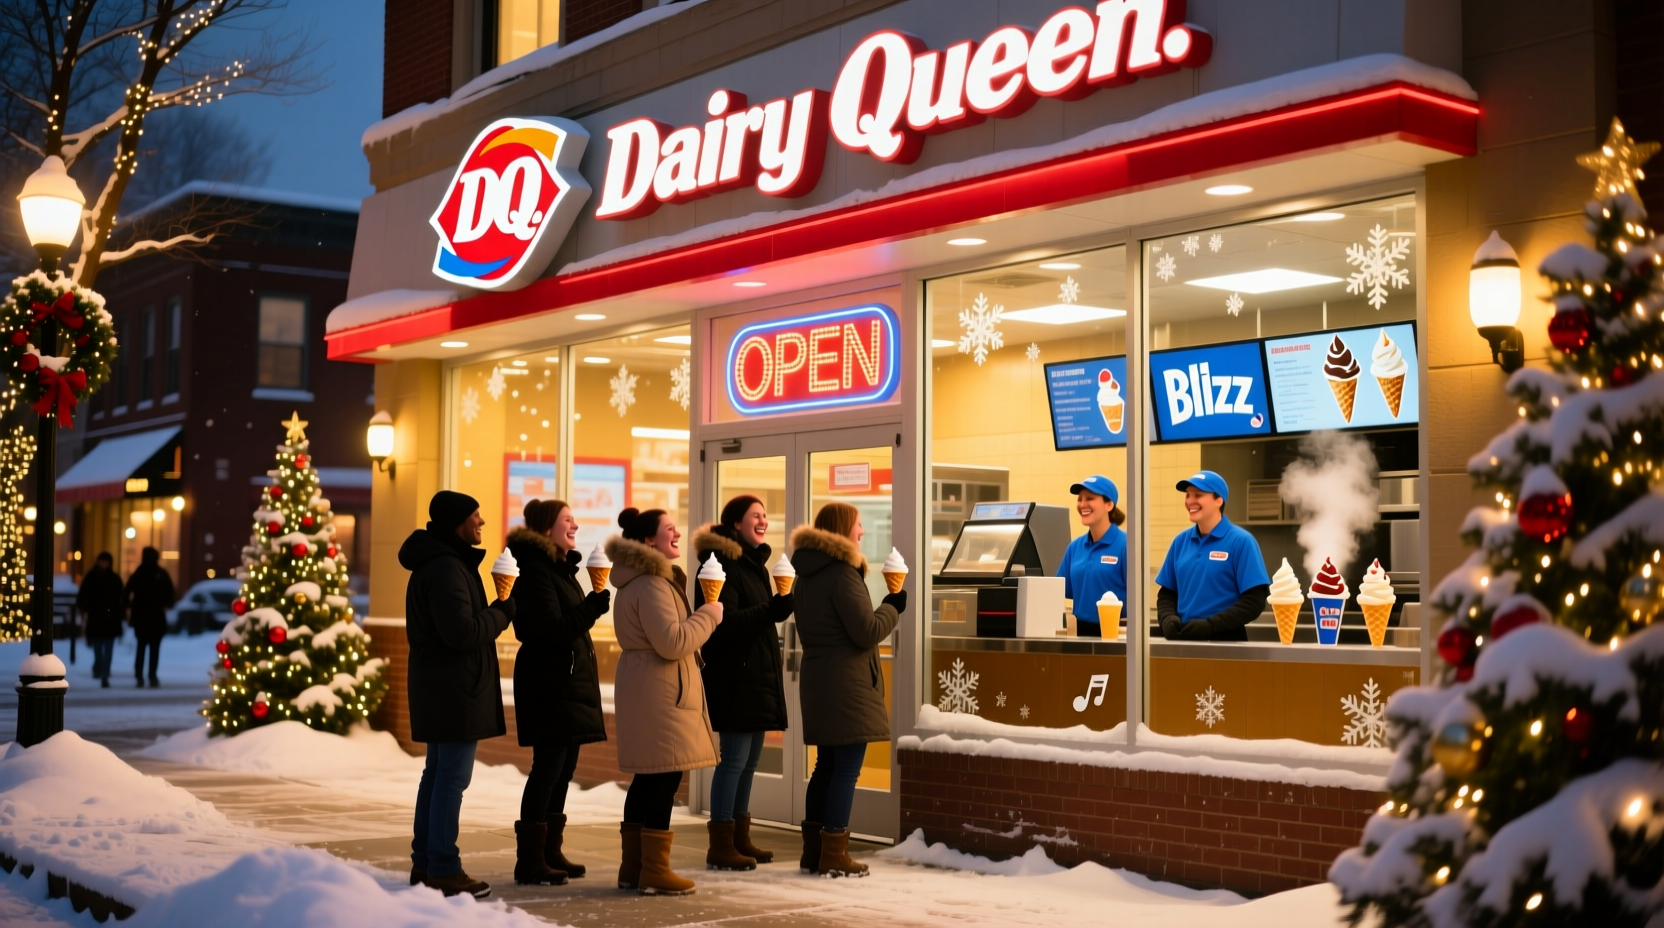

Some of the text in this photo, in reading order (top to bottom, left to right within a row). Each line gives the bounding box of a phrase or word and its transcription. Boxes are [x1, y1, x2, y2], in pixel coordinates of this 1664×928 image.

[595, 90, 814, 217] Dairy
[734, 319, 881, 401] OPEN
[1162, 361, 1254, 426] Blizz
